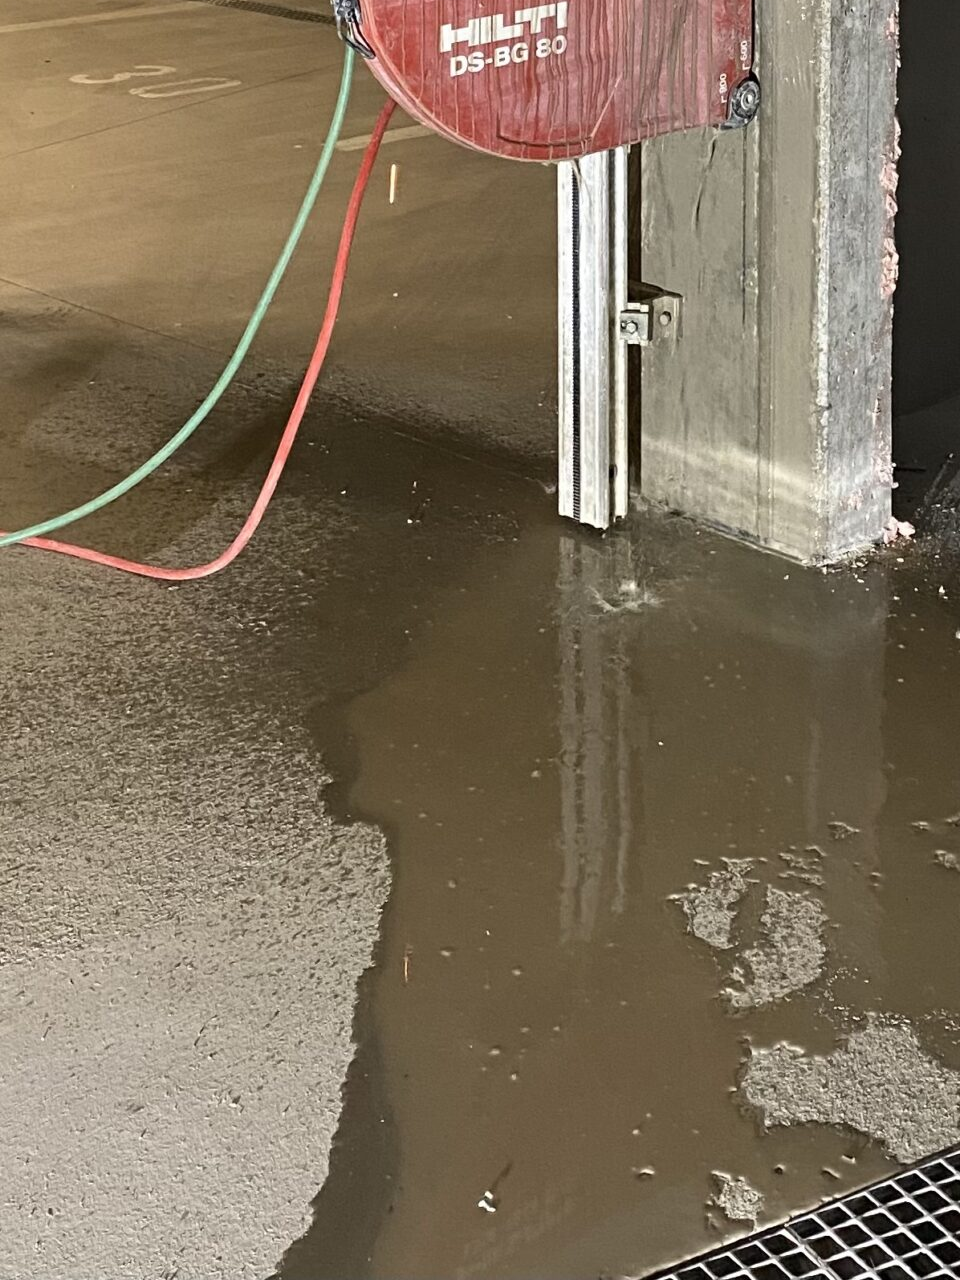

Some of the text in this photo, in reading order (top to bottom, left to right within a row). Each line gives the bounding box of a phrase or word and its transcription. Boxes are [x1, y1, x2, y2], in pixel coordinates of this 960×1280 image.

[440, 1, 568, 53] HILTI
[450, 34, 568, 77] DS-BG 80
